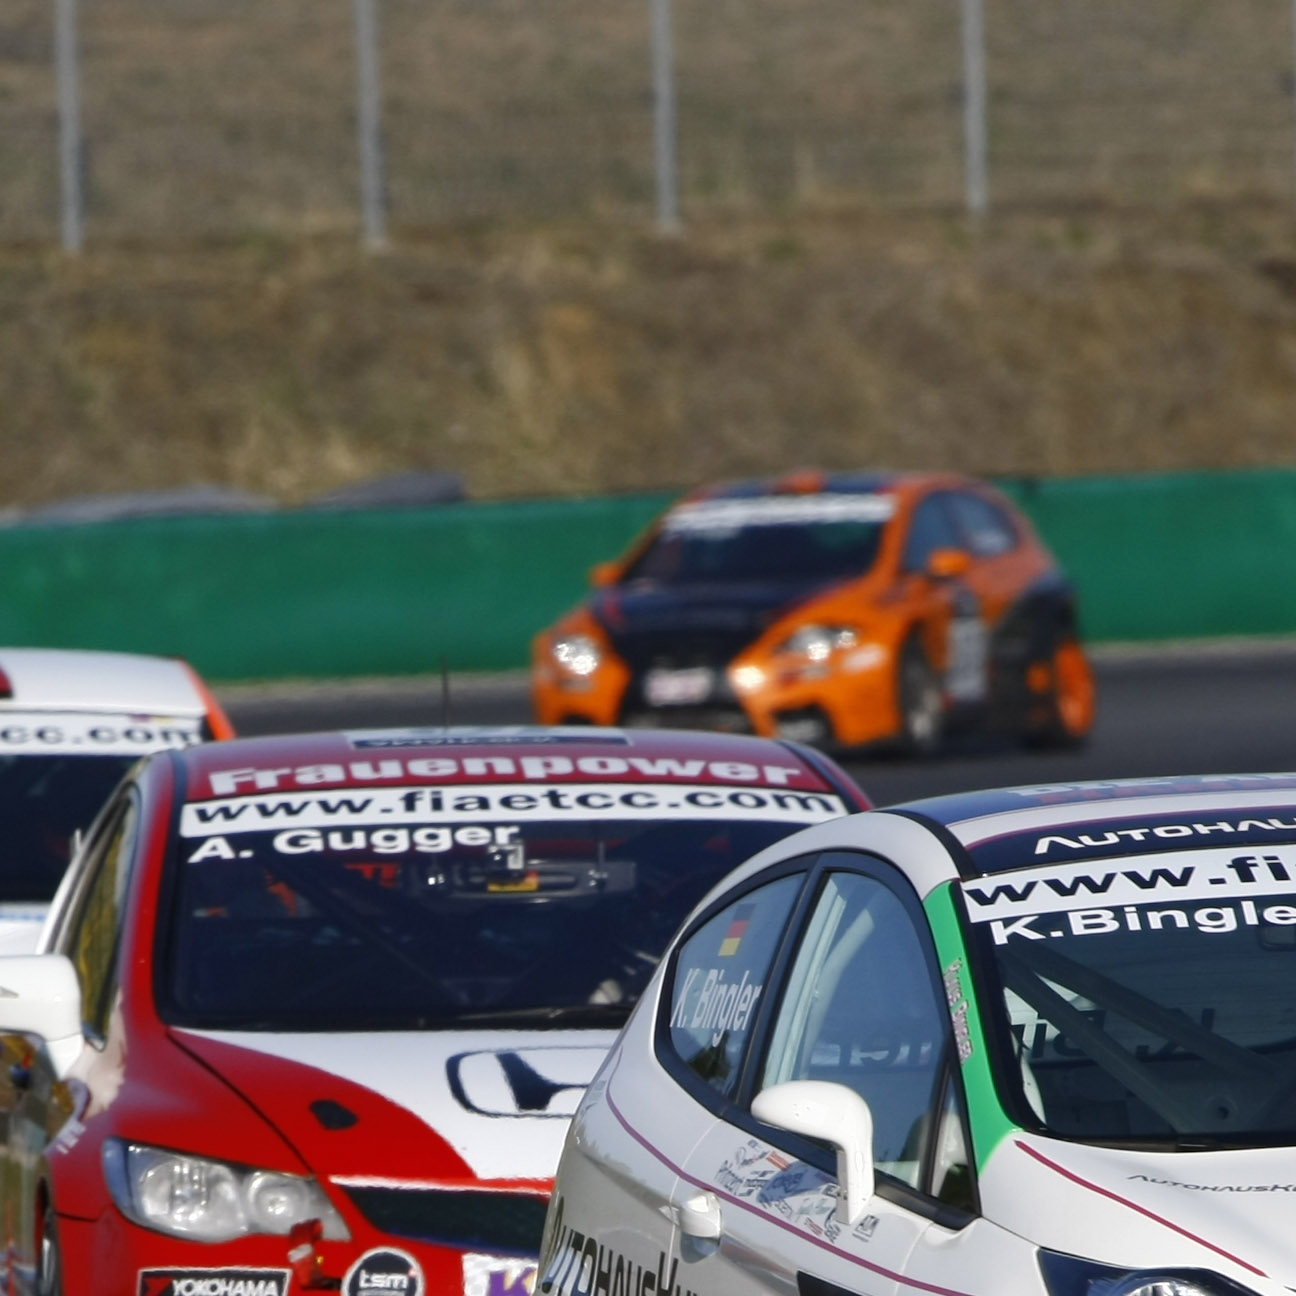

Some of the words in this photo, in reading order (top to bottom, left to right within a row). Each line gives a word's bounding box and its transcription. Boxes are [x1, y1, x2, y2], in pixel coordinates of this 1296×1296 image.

[207, 754, 802, 796] Frauenpower
[194, 788, 840, 824] www.fiaetcc.com
[187, 836, 253, 863] A.
[273, 823, 522, 854] Gugger
[691, 967, 763, 1048] Bingler
[359, 1269, 408, 1289] tsm
